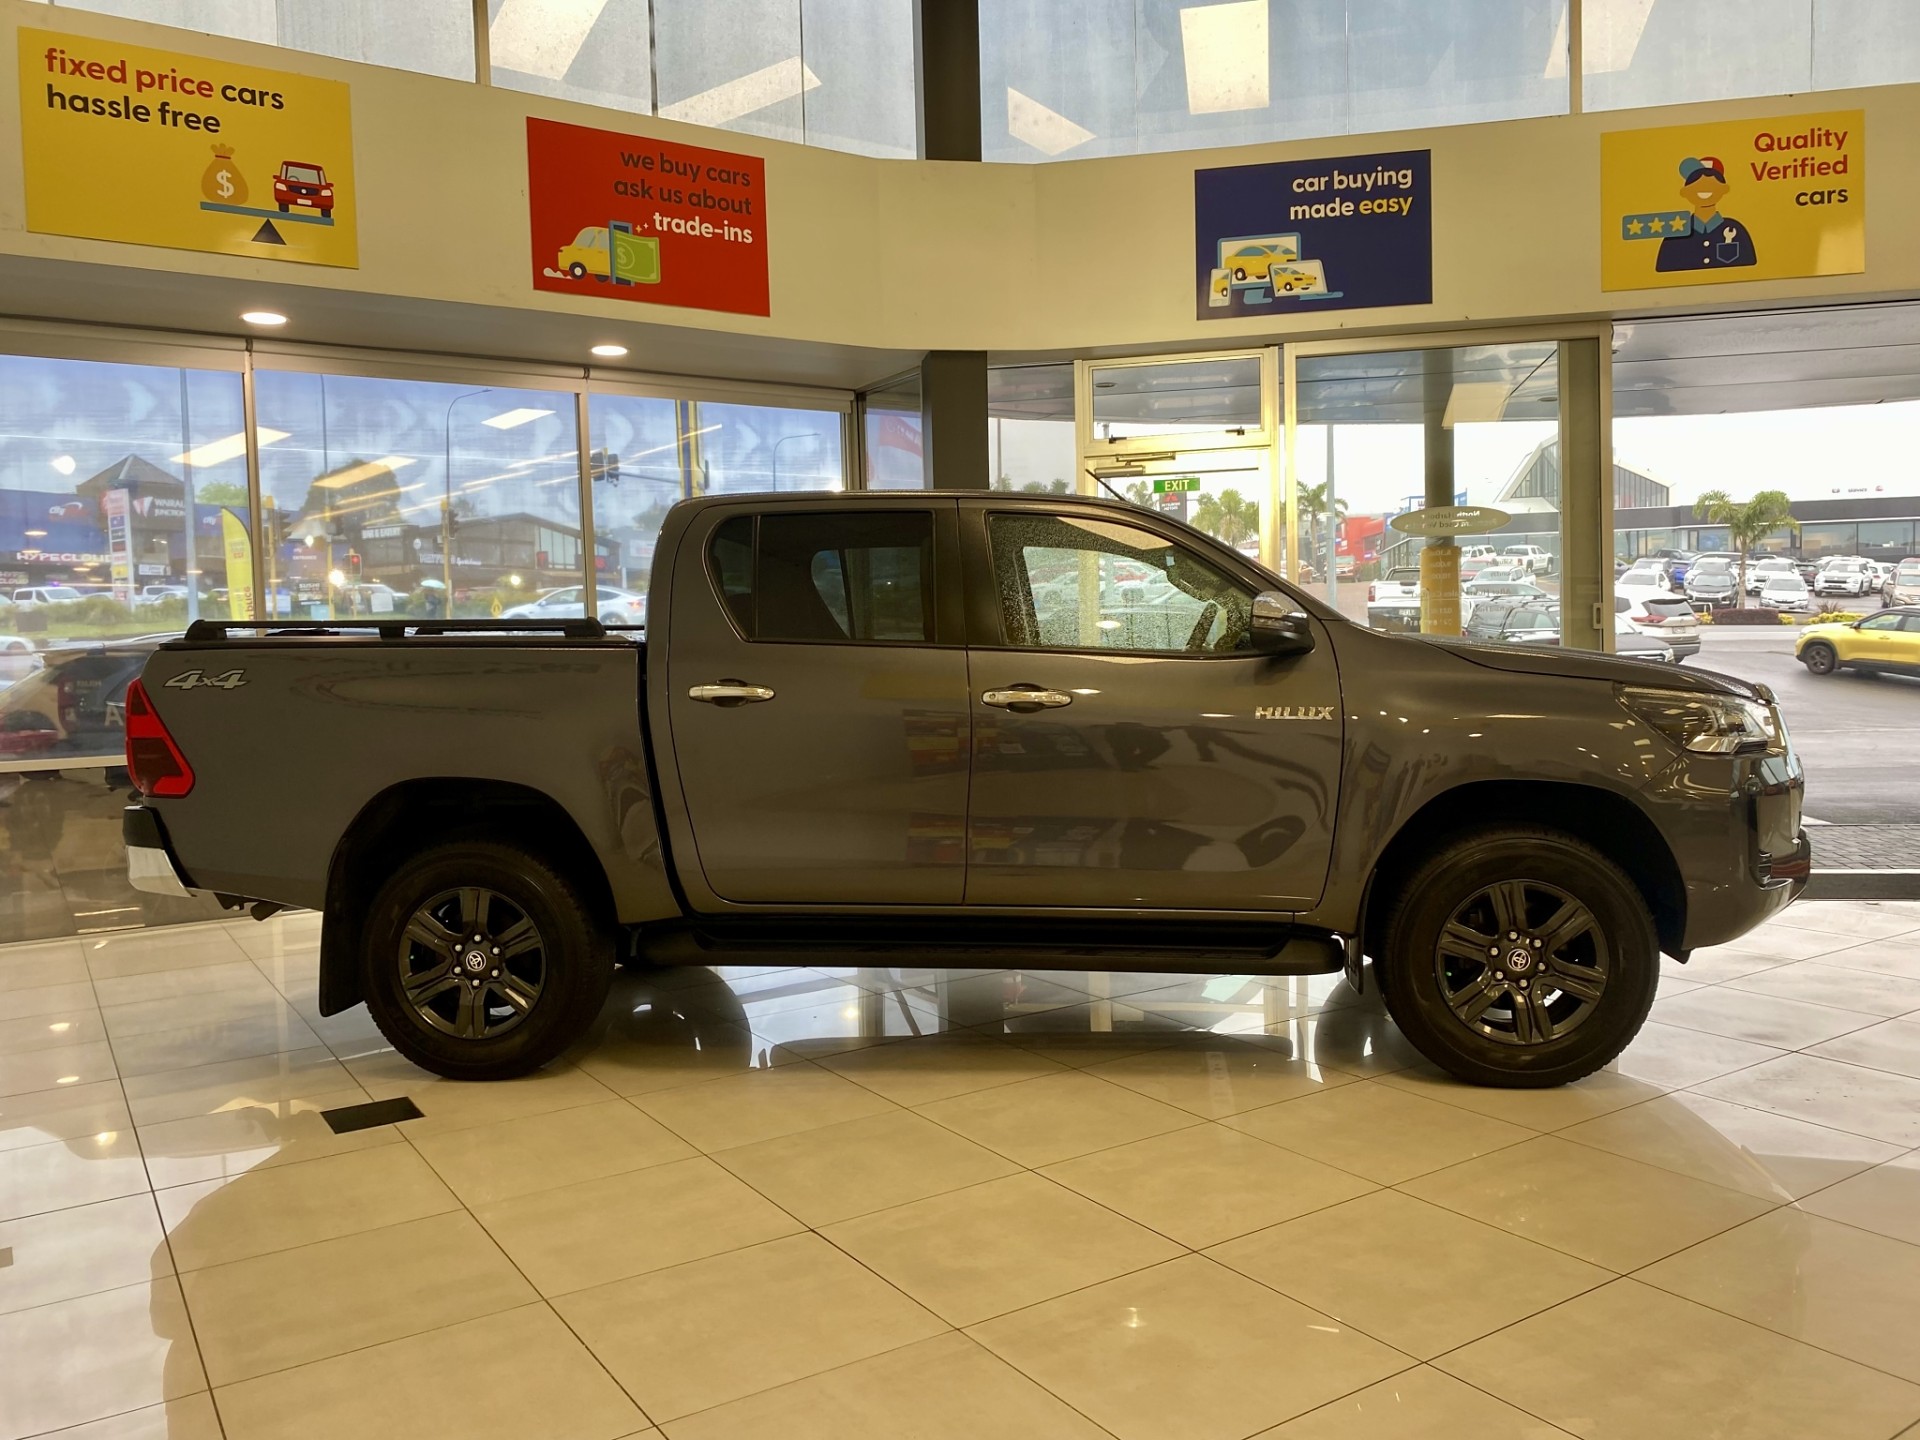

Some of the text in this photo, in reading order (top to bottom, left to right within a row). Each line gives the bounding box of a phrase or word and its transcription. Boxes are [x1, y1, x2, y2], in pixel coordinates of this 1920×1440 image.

[45, 48, 284, 110] fixed price cars
[47, 83, 221, 134] hassle free
[1754, 127, 1848, 152] Quality
[620, 152, 750, 187] we buy cars
[1292, 166, 1412, 193] car buying
[1750, 154, 1848, 181] Verified
[613, 179, 752, 215] ask us about
[1290, 196, 1413, 220] made easy
[1795, 187, 1848, 207] cars
[653, 212, 753, 244] trade-ins
[1165, 480, 1189, 491] EXIT
[16, 552, 113, 563] HYPECLOUD
[162, 668, 249, 690] 4x4
[1255, 706, 1334, 720] HILUX
